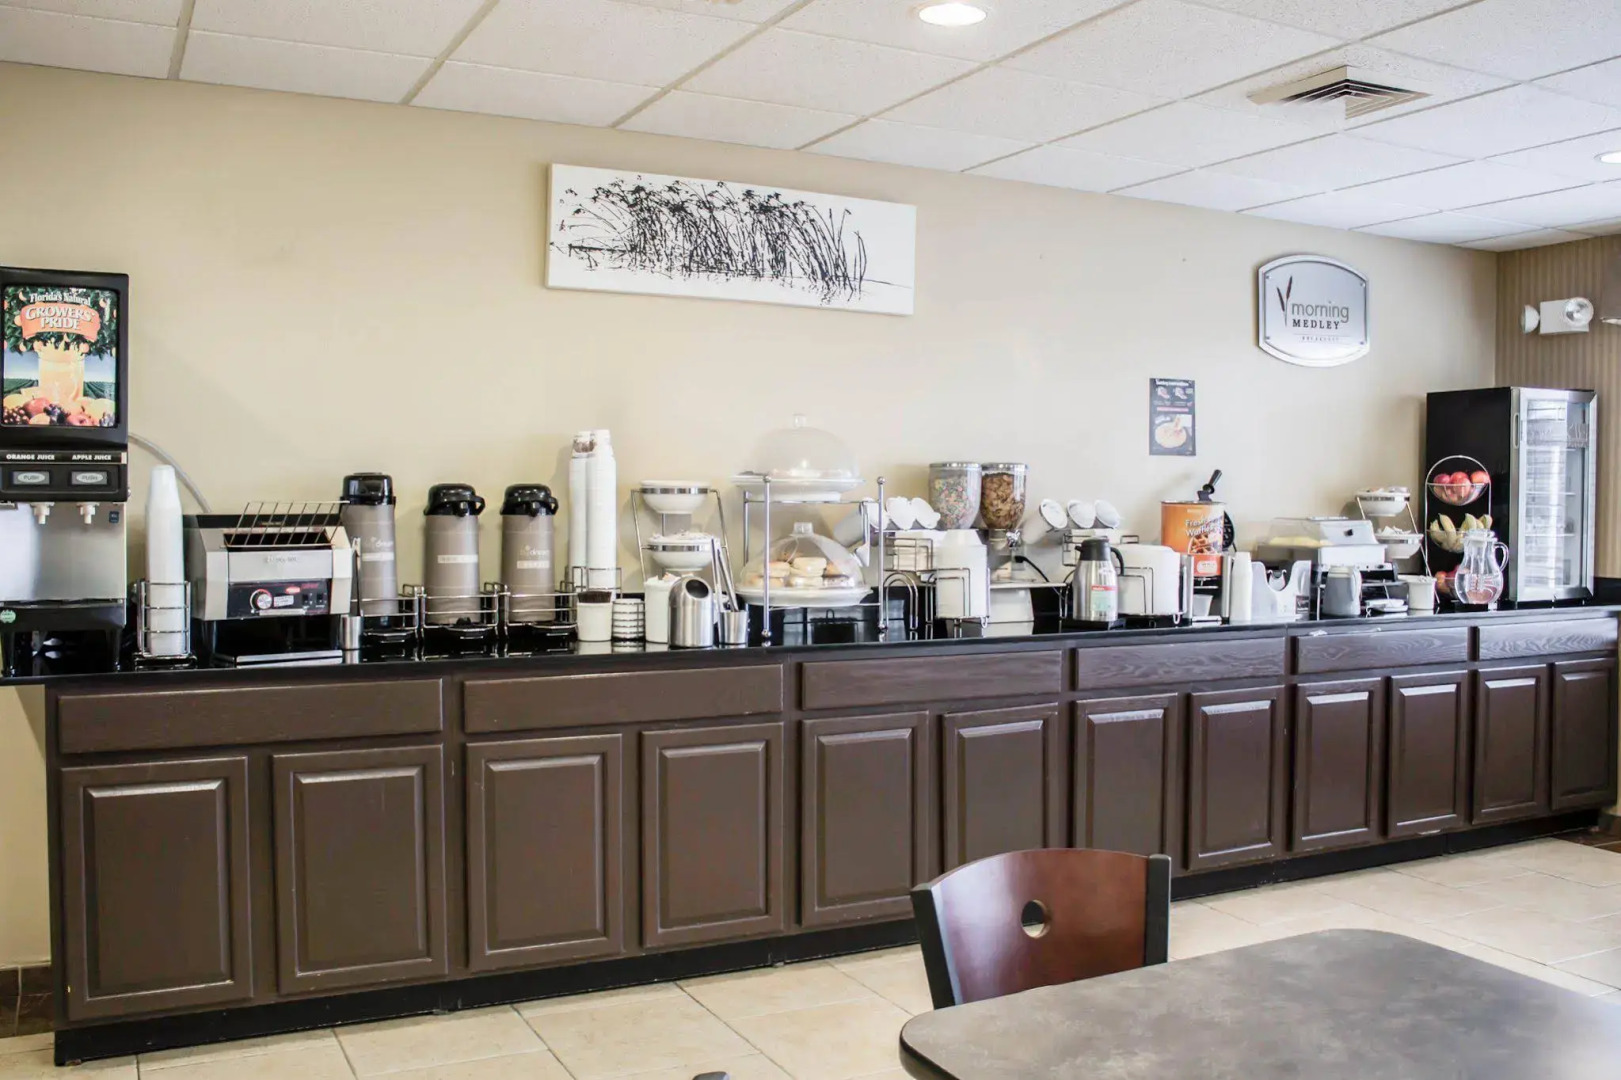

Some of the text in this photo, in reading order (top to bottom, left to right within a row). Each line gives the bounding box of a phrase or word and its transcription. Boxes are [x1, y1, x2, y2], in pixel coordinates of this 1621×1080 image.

[1291, 300, 1349, 323] morning
[40, 316, 81, 330] PRIDE
[1292, 318, 1340, 330] MEDLEY
[6, 453, 55, 461] ORANGE JUICE
